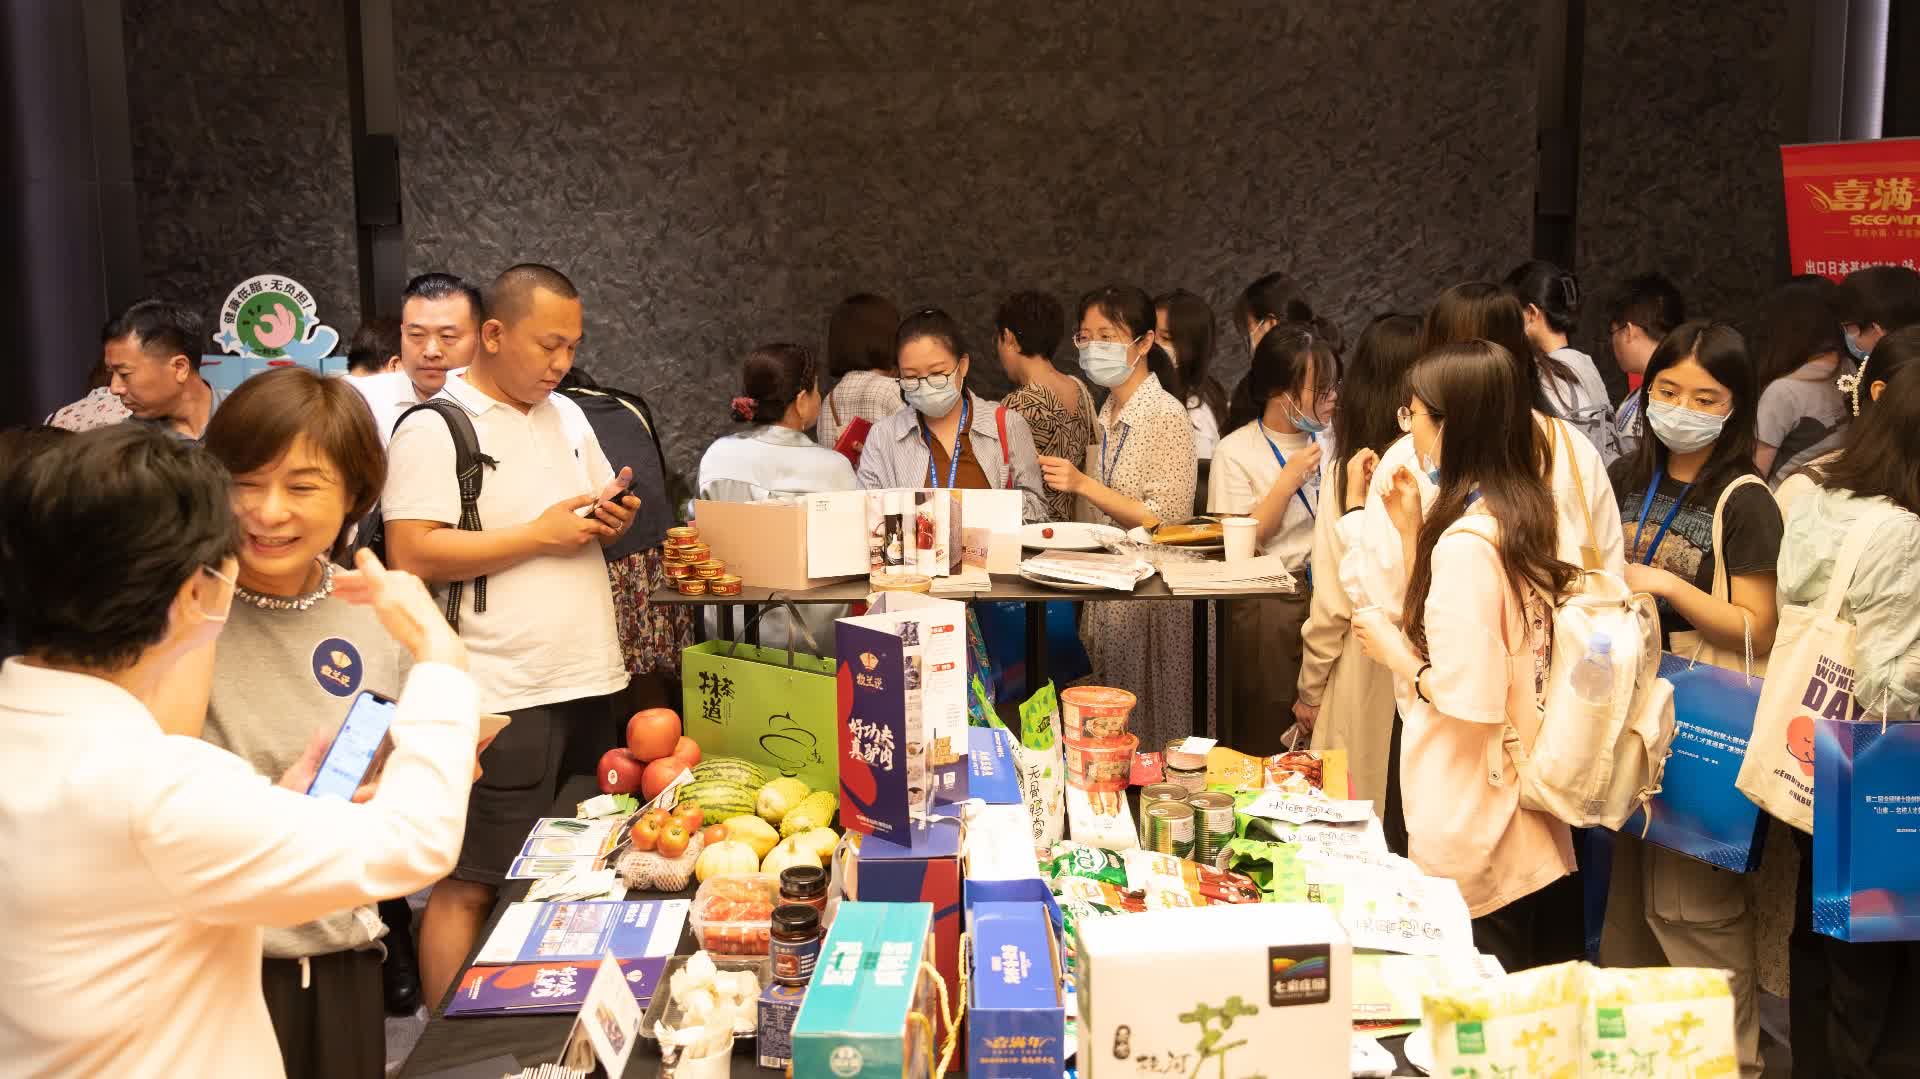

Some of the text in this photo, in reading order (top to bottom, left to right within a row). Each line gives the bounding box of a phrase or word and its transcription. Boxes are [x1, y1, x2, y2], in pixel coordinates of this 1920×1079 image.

[1831, 177, 1920, 211] 喜满
[848, 718, 895, 750] 好功夫
[848, 738, 894, 771] 真驴肉
